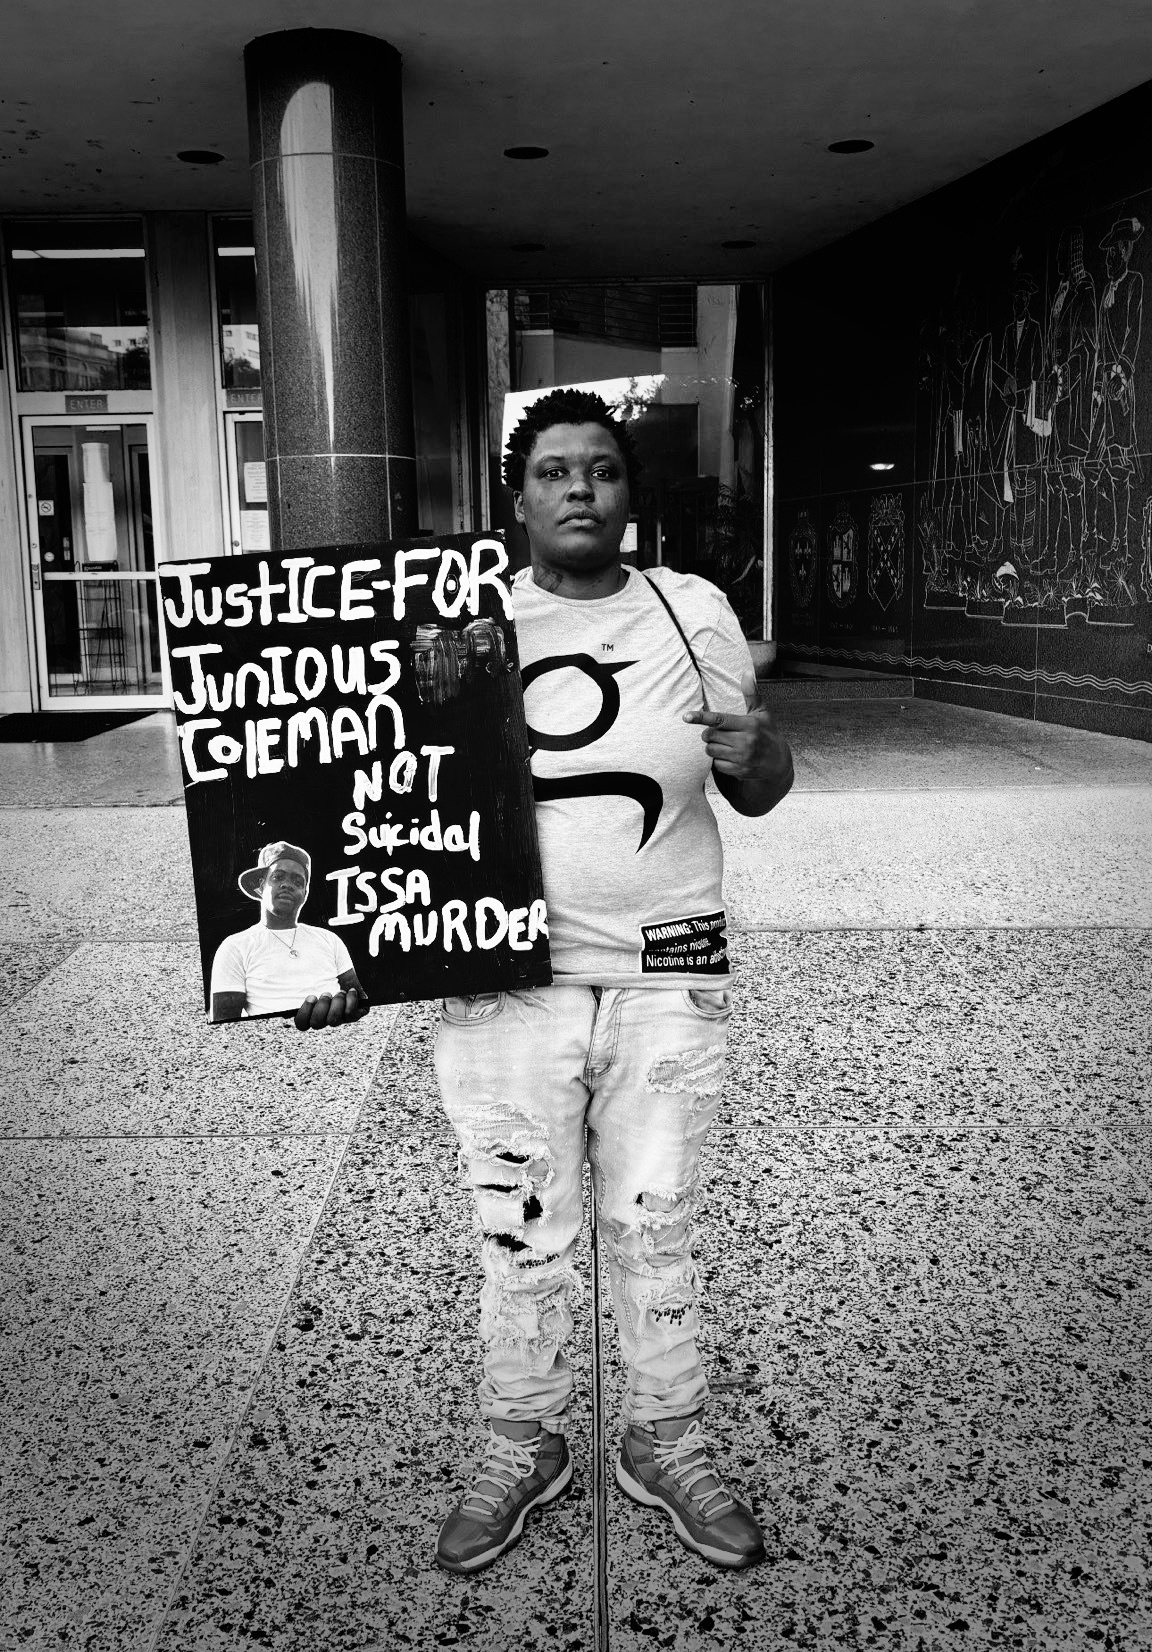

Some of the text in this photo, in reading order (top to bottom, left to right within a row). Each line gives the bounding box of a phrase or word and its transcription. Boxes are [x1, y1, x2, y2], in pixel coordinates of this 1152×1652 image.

[70, 399, 104, 410] ENTER
[601, 643, 614, 651] TM
[353, 745, 455, 810] NOT
[342, 809, 481, 861] Suicidal
[369, 897, 550, 957] MURDER
[645, 923, 693, 941] WARNING:
[691, 920, 710, 932] This
[696, 955, 707, 965] an
